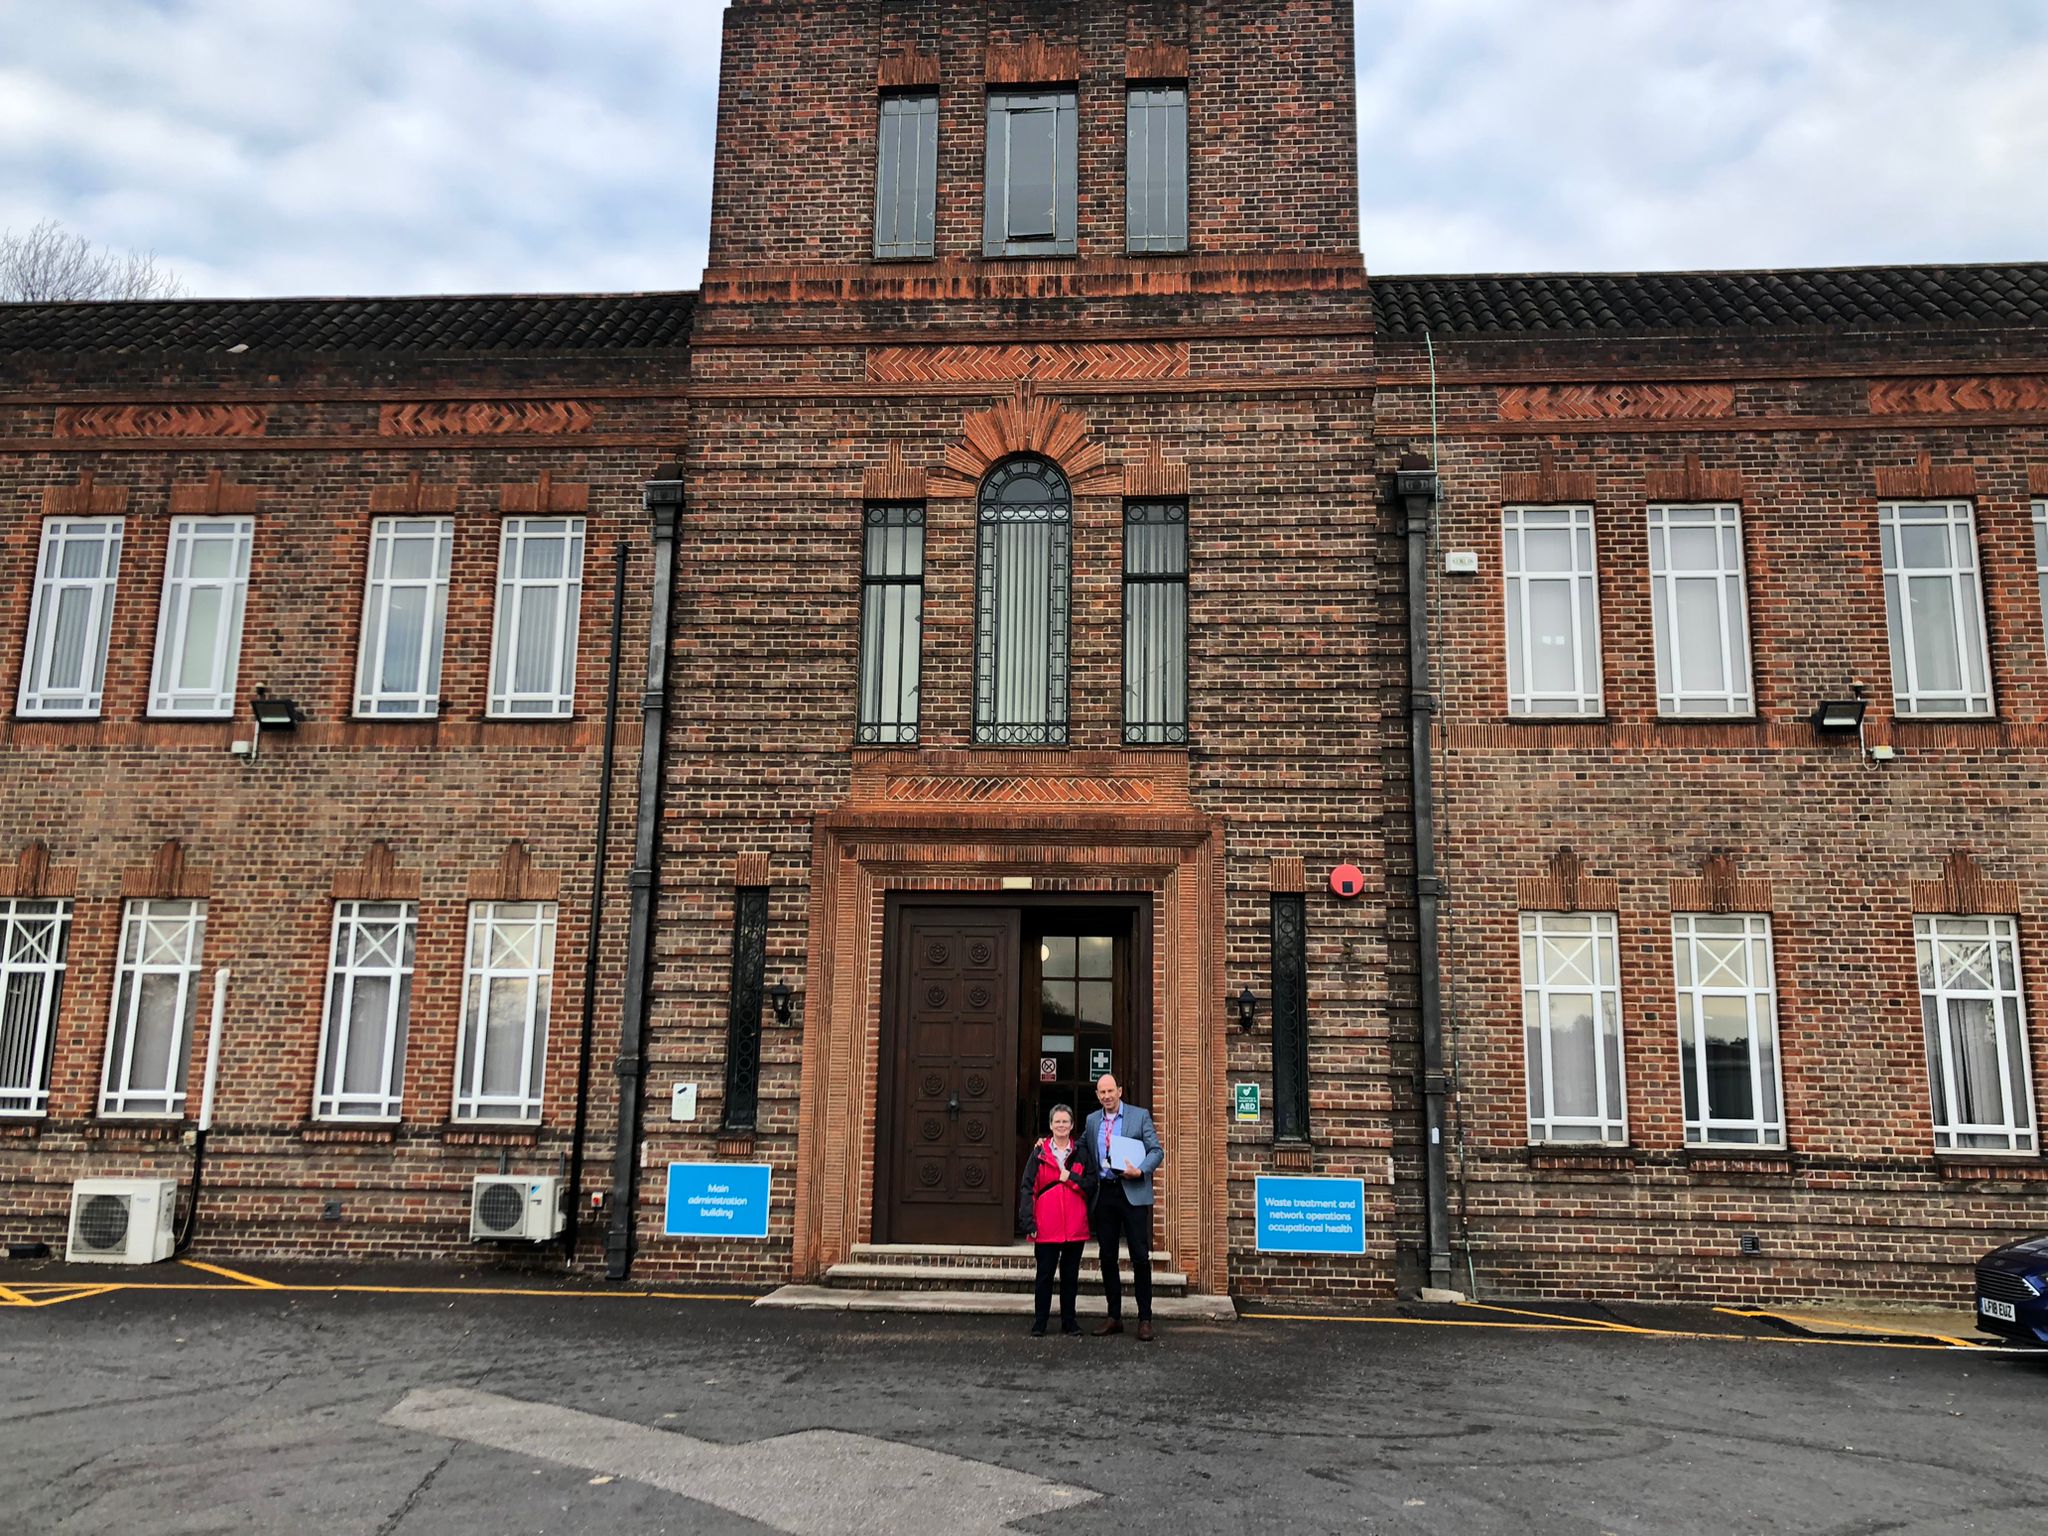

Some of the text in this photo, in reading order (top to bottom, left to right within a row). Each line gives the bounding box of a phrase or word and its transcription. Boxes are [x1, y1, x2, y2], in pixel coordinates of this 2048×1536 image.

[707, 1184, 729, 1193] Main
[688, 1196, 748, 1206] administration
[1264, 1197, 1356, 1209] Waste treatment and
[700, 1208, 734, 1219] building
[1269, 1210, 1352, 1222] network operations
[1268, 1223, 1353, 1234] occupational health
[1998, 1303, 2012, 1318] EUZ
